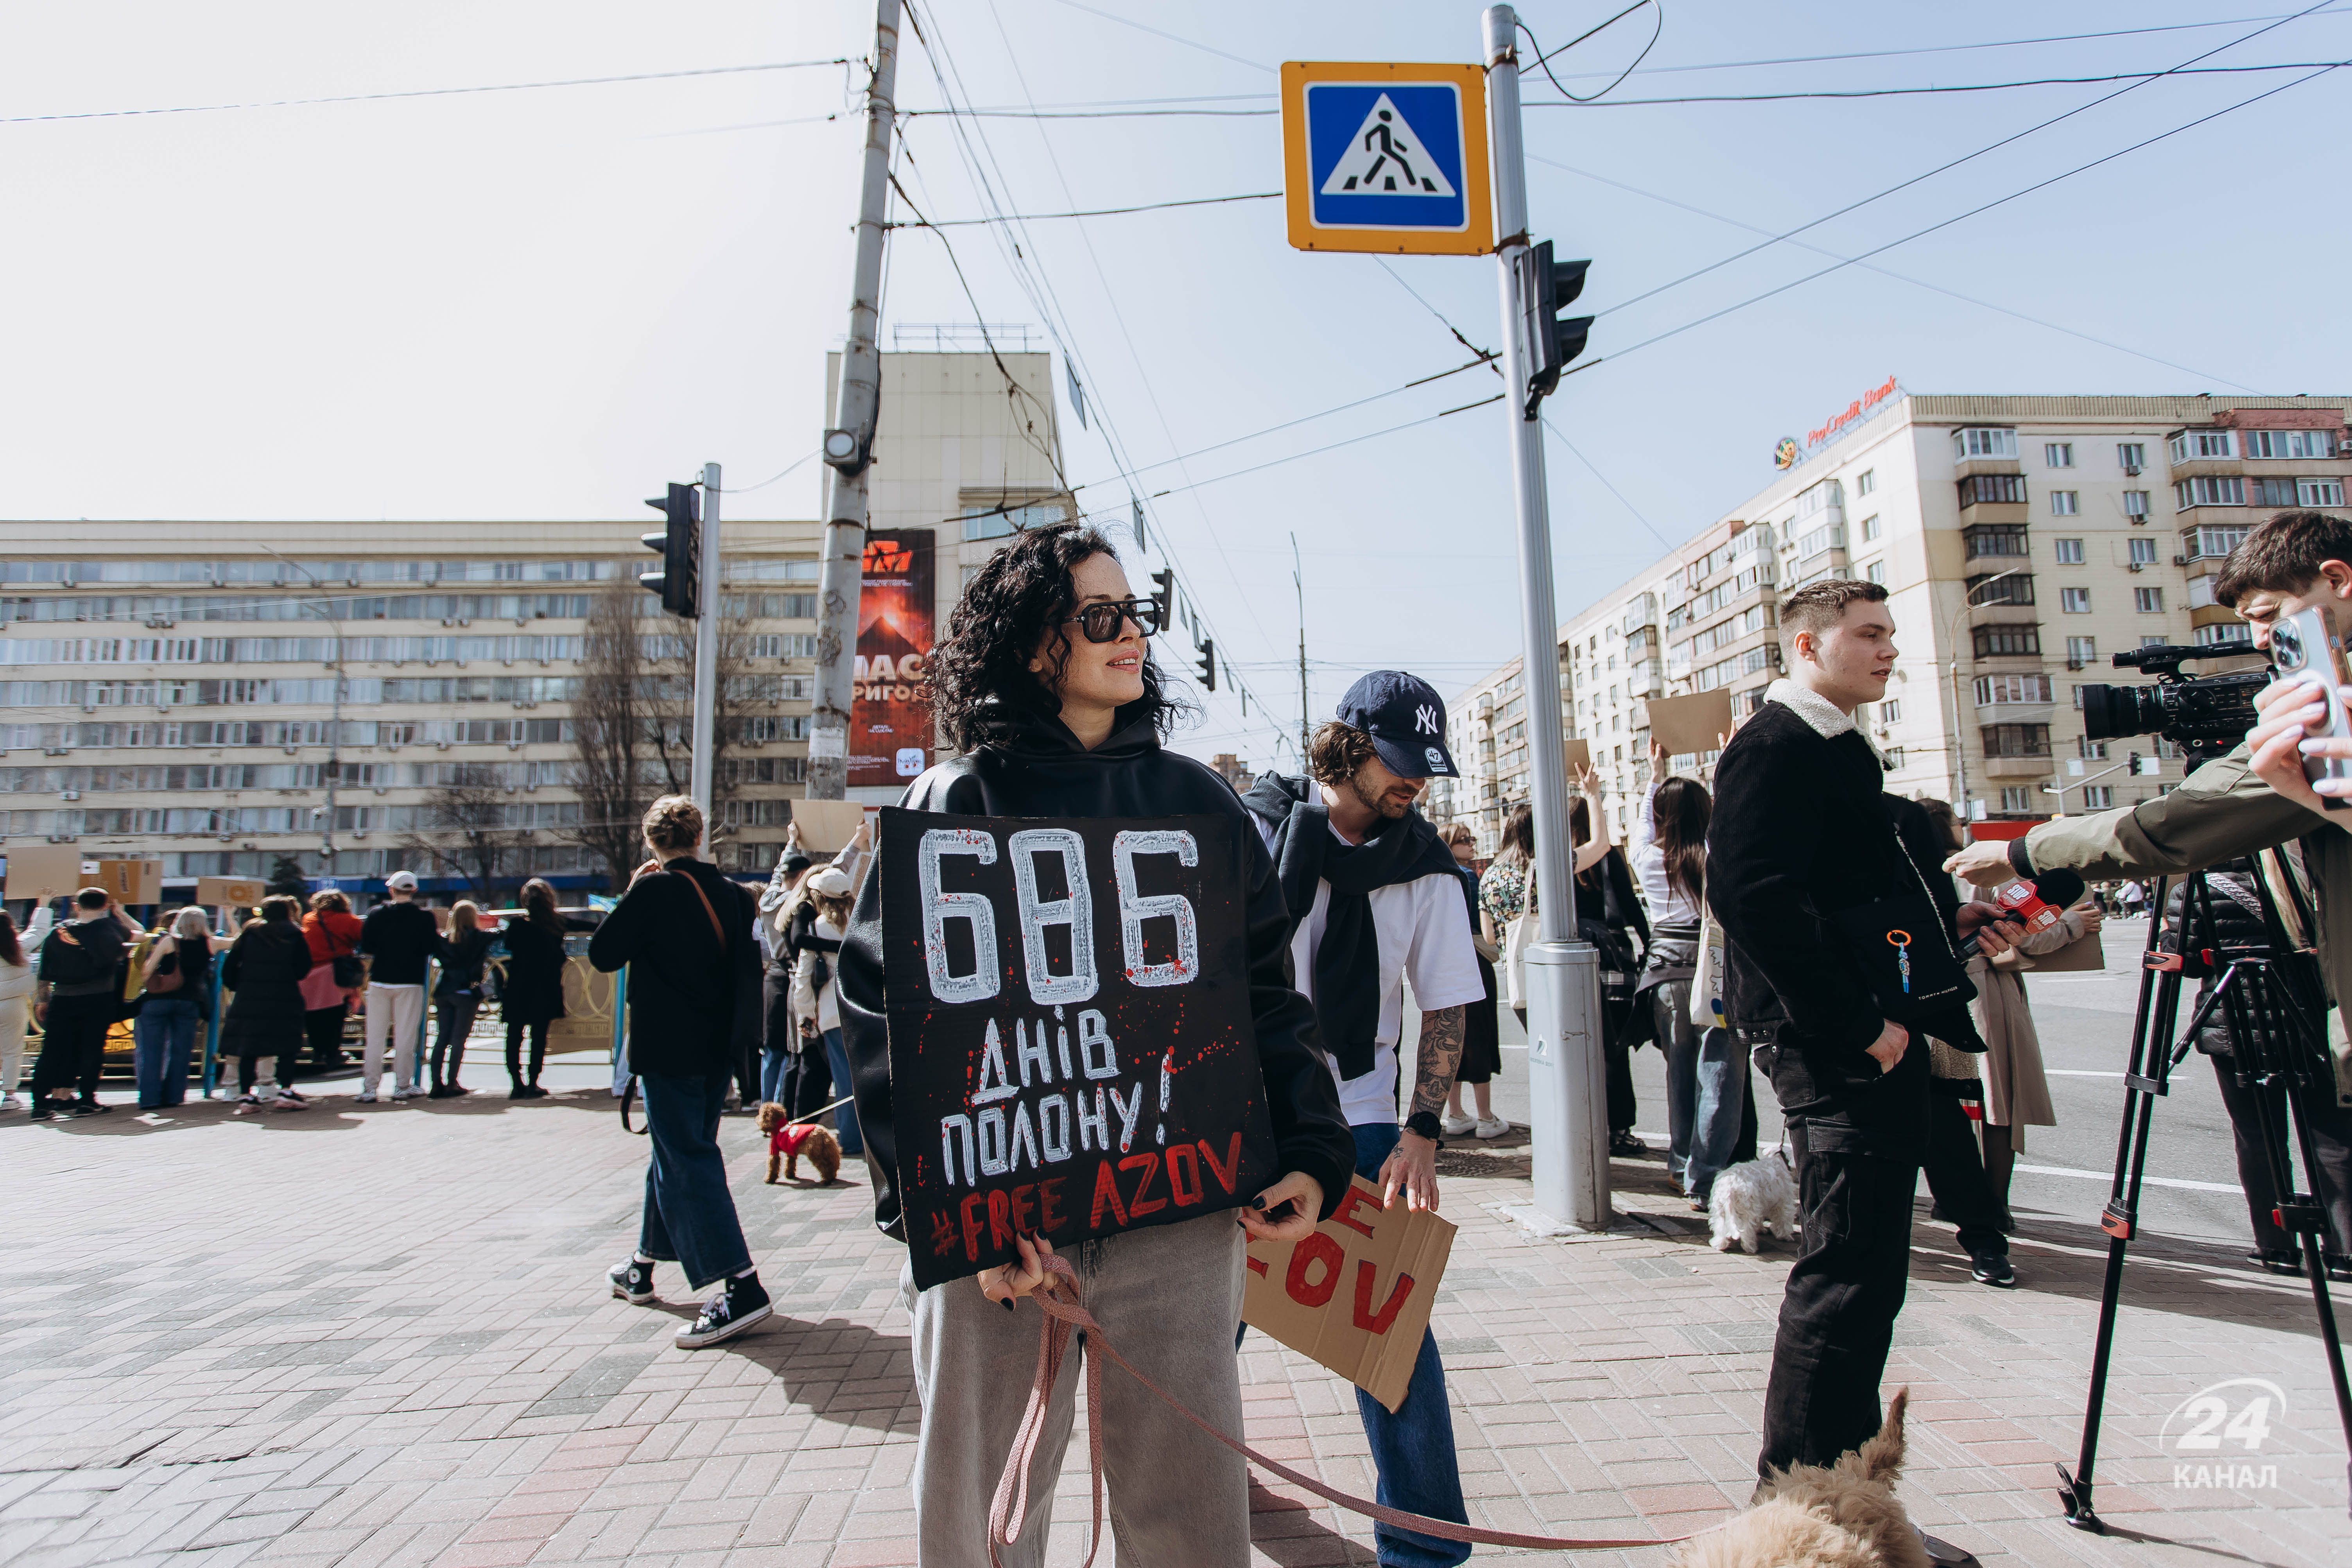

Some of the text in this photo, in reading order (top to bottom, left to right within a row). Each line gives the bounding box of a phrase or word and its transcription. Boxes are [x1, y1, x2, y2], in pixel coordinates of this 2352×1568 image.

[1808, 375, 1896, 448] ProCredit Bank
[1415, 704, 1438, 734] NY
[918, 828, 1199, 1005] 686
[2006, 884, 2030, 900] STOP
[2037, 910, 2056, 926] STOP
[941, 1053, 1171, 1187] ПОЛОНУ!
[931, 1132, 1242, 1262] #FREE AZOV
